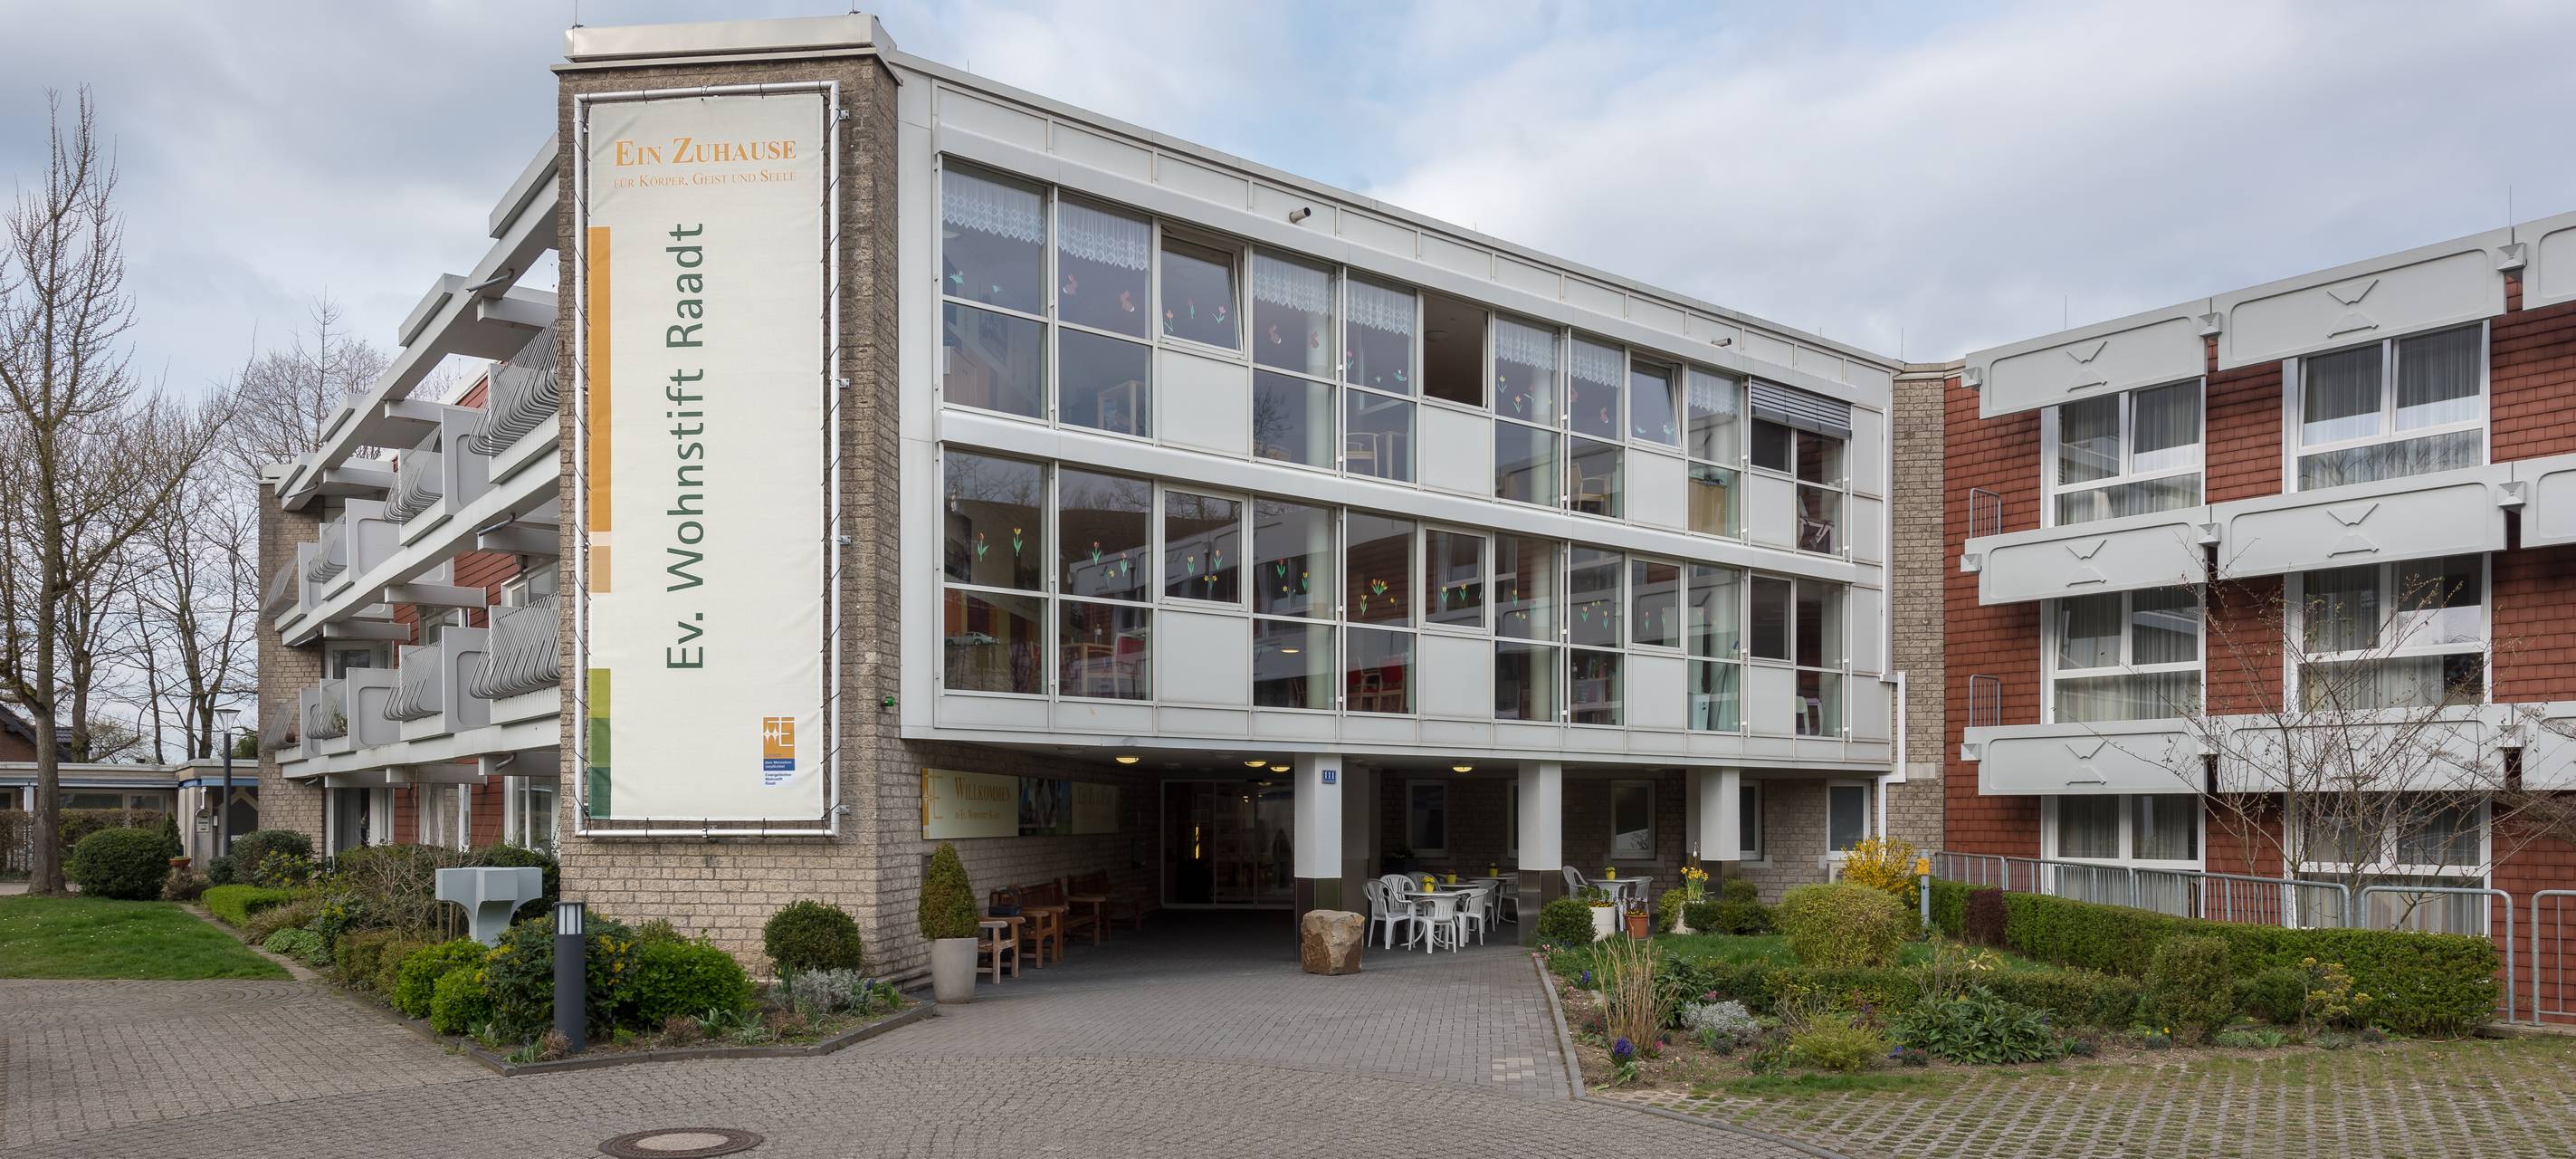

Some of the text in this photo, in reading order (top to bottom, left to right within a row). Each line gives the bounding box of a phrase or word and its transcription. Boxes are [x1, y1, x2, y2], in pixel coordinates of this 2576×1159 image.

[615, 137, 797, 167] EIN ZUHAUSE
[692, 172, 727, 186] GEIST
[730, 173, 757, 184] UND
[760, 168, 797, 182] SEELE
[666, 223, 703, 668] Ev. Wohnstift Raadt
[955, 776, 1011, 802] WILLKOMMEN
